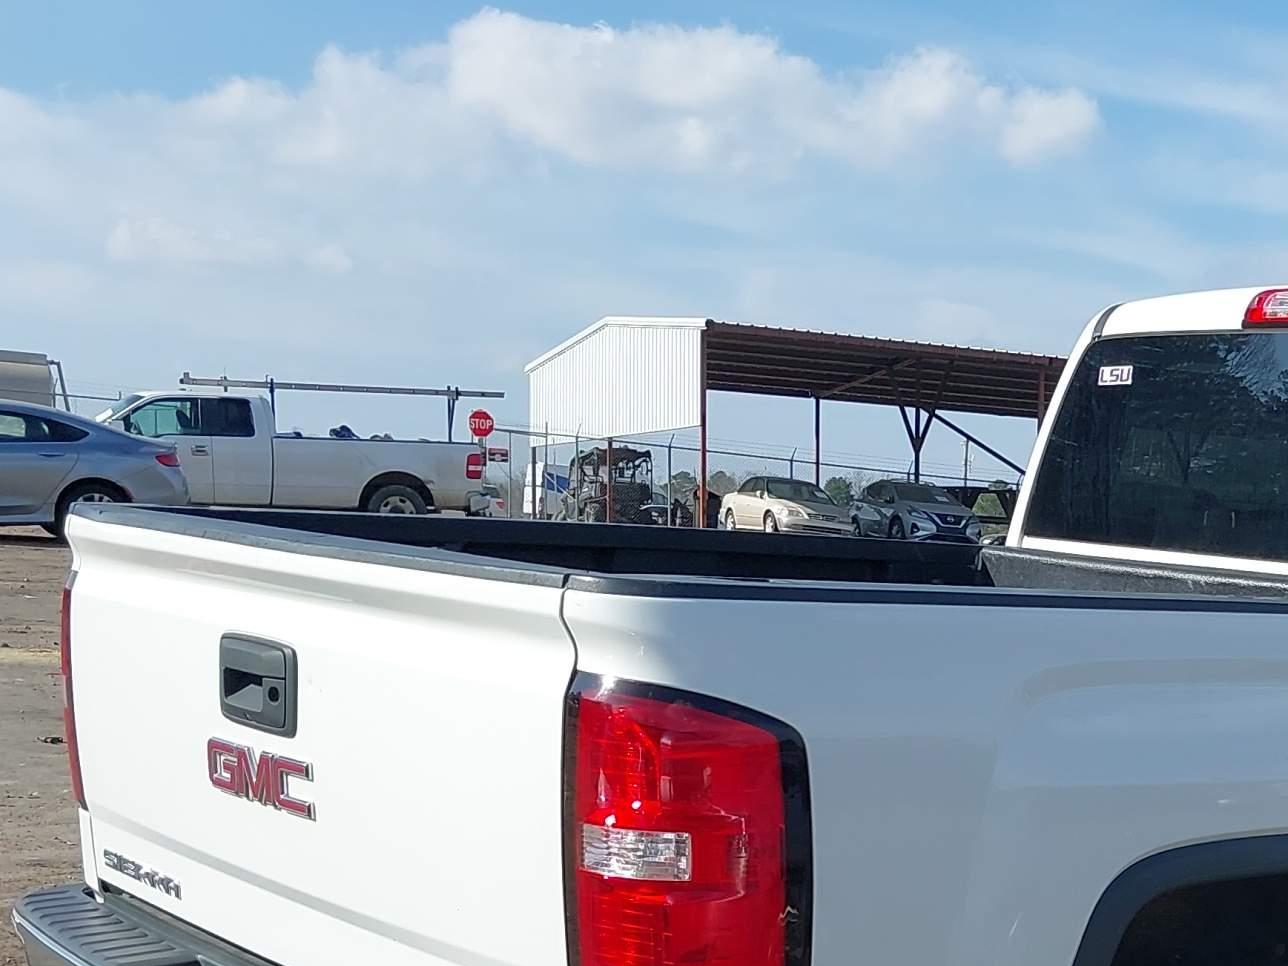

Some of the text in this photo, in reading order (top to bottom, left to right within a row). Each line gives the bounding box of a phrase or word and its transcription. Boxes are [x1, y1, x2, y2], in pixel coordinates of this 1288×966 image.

[1100, 367, 1131, 383] LSU
[470, 418, 493, 430] STOP
[207, 736, 317, 822] GMC
